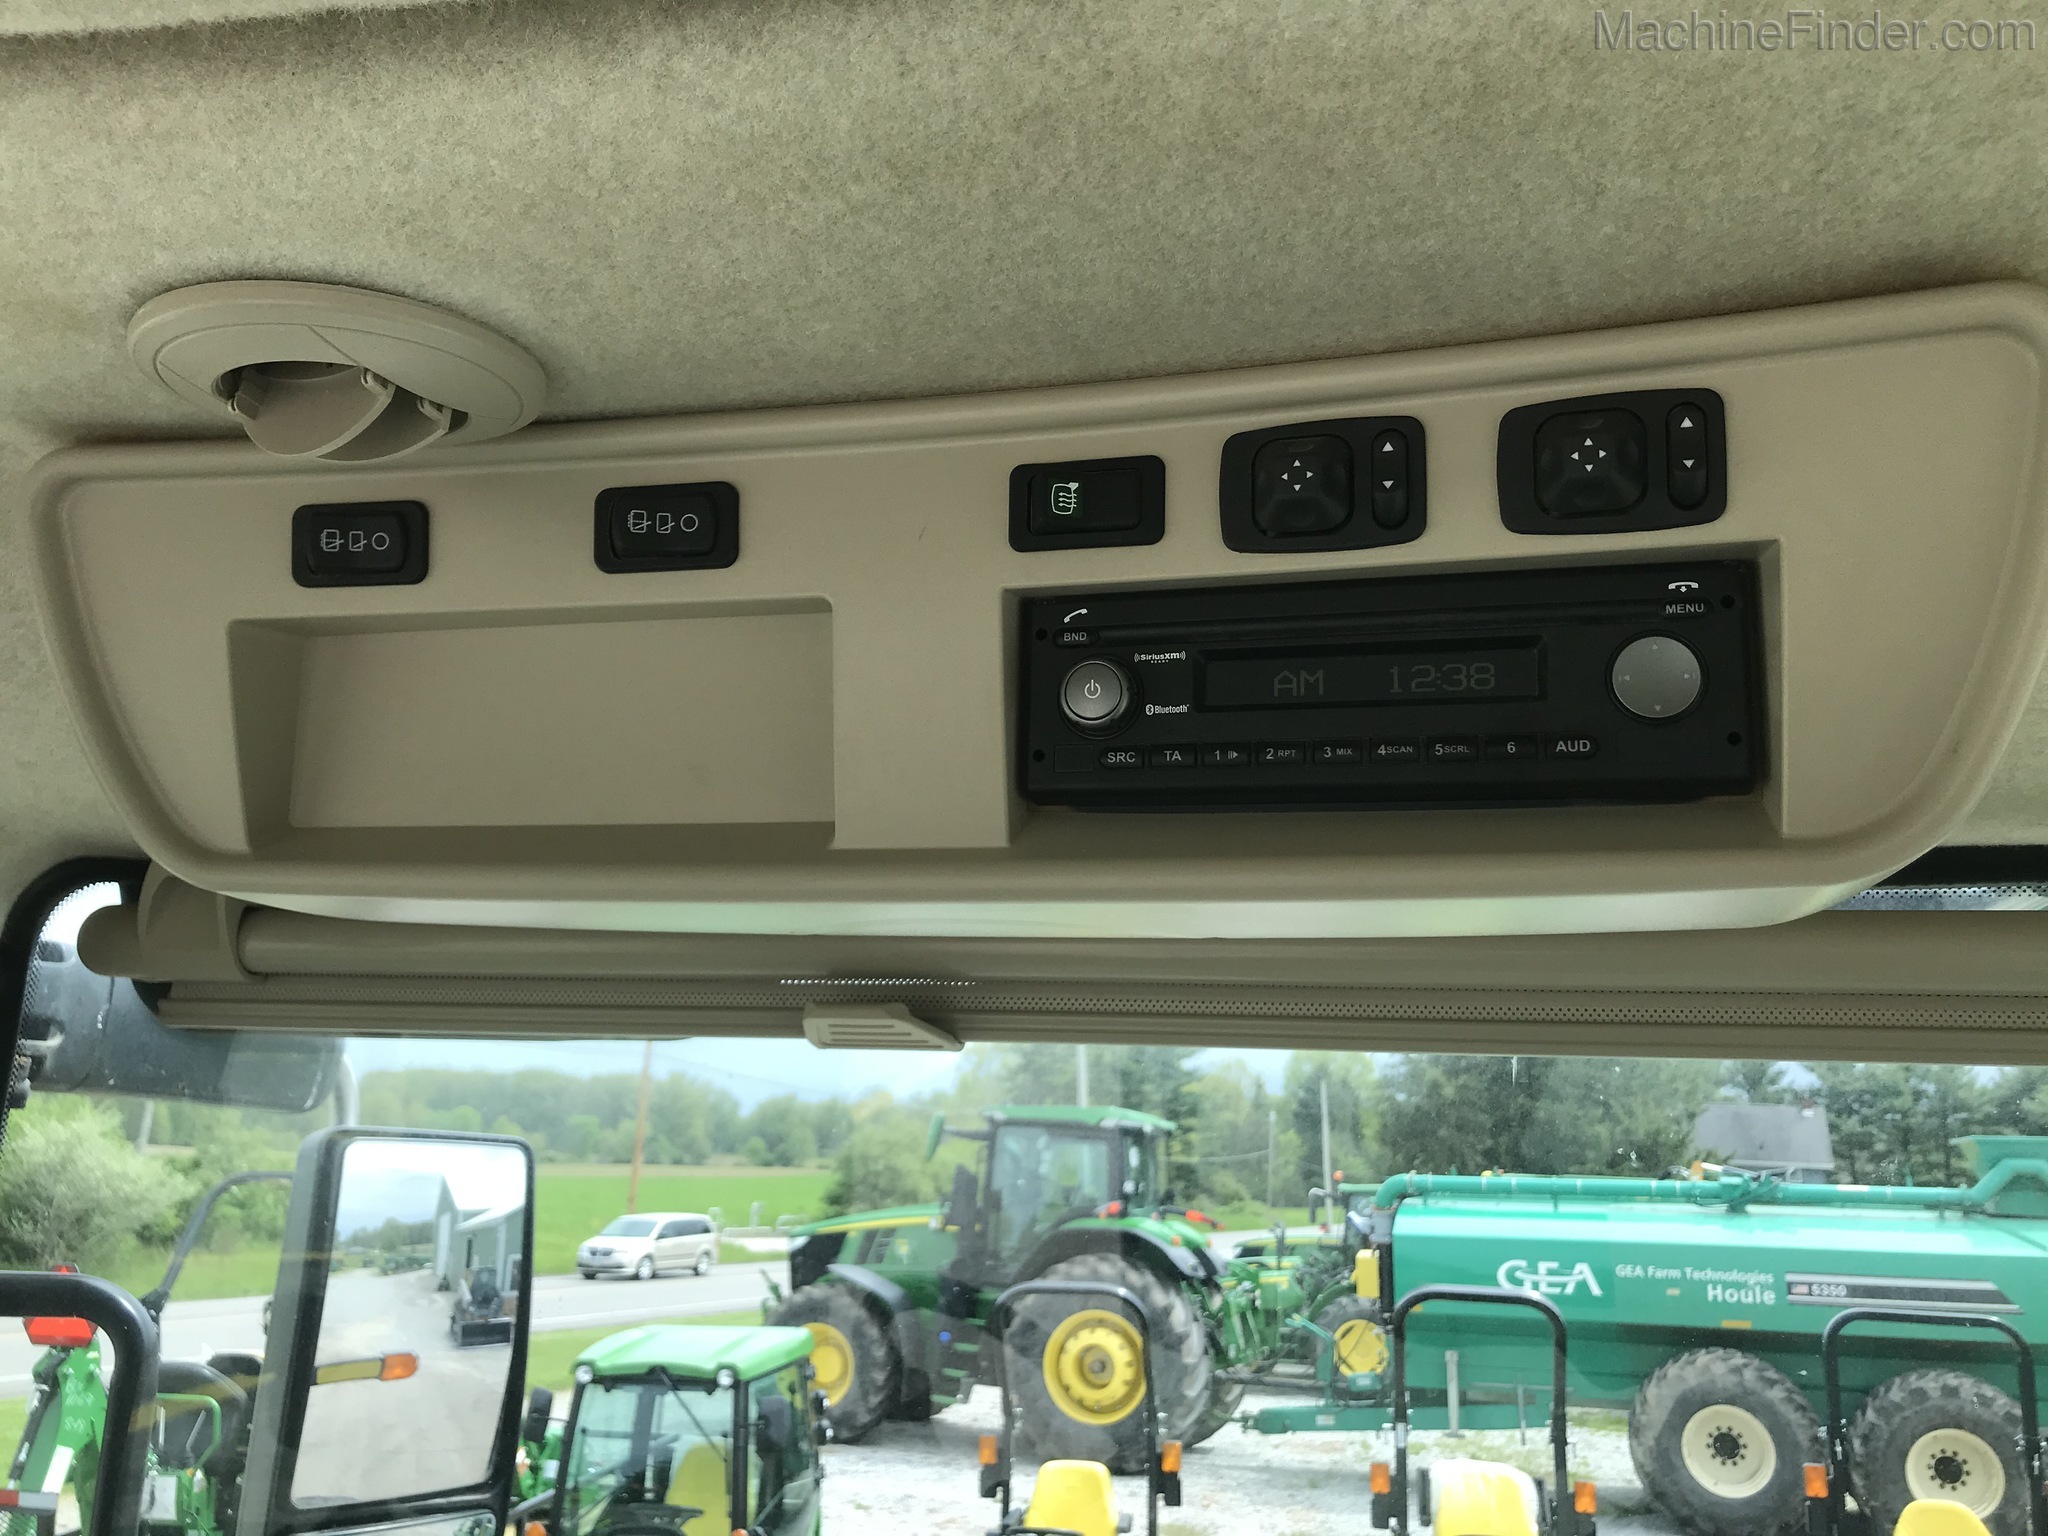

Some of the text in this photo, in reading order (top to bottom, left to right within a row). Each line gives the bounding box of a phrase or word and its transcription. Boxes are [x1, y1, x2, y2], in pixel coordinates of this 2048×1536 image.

[1665, 603, 1705, 614] MENU
[1063, 631, 1087, 642] BND
[1273, 662, 1496, 697] AM 12:38
[1154, 704, 1189, 714] Bluetooth
[1507, 742, 1516, 753] 6
[1555, 740, 1591, 753] AUD
[1106, 751, 1136, 764] SRC
[1164, 750, 1182, 762] TA
[1214, 751, 1221, 761] 1
[1496, 1258, 1604, 1297] GEA
[1615, 1263, 1775, 1285] GEA Farm Technologies
[1706, 1282, 1776, 1306] Houle
